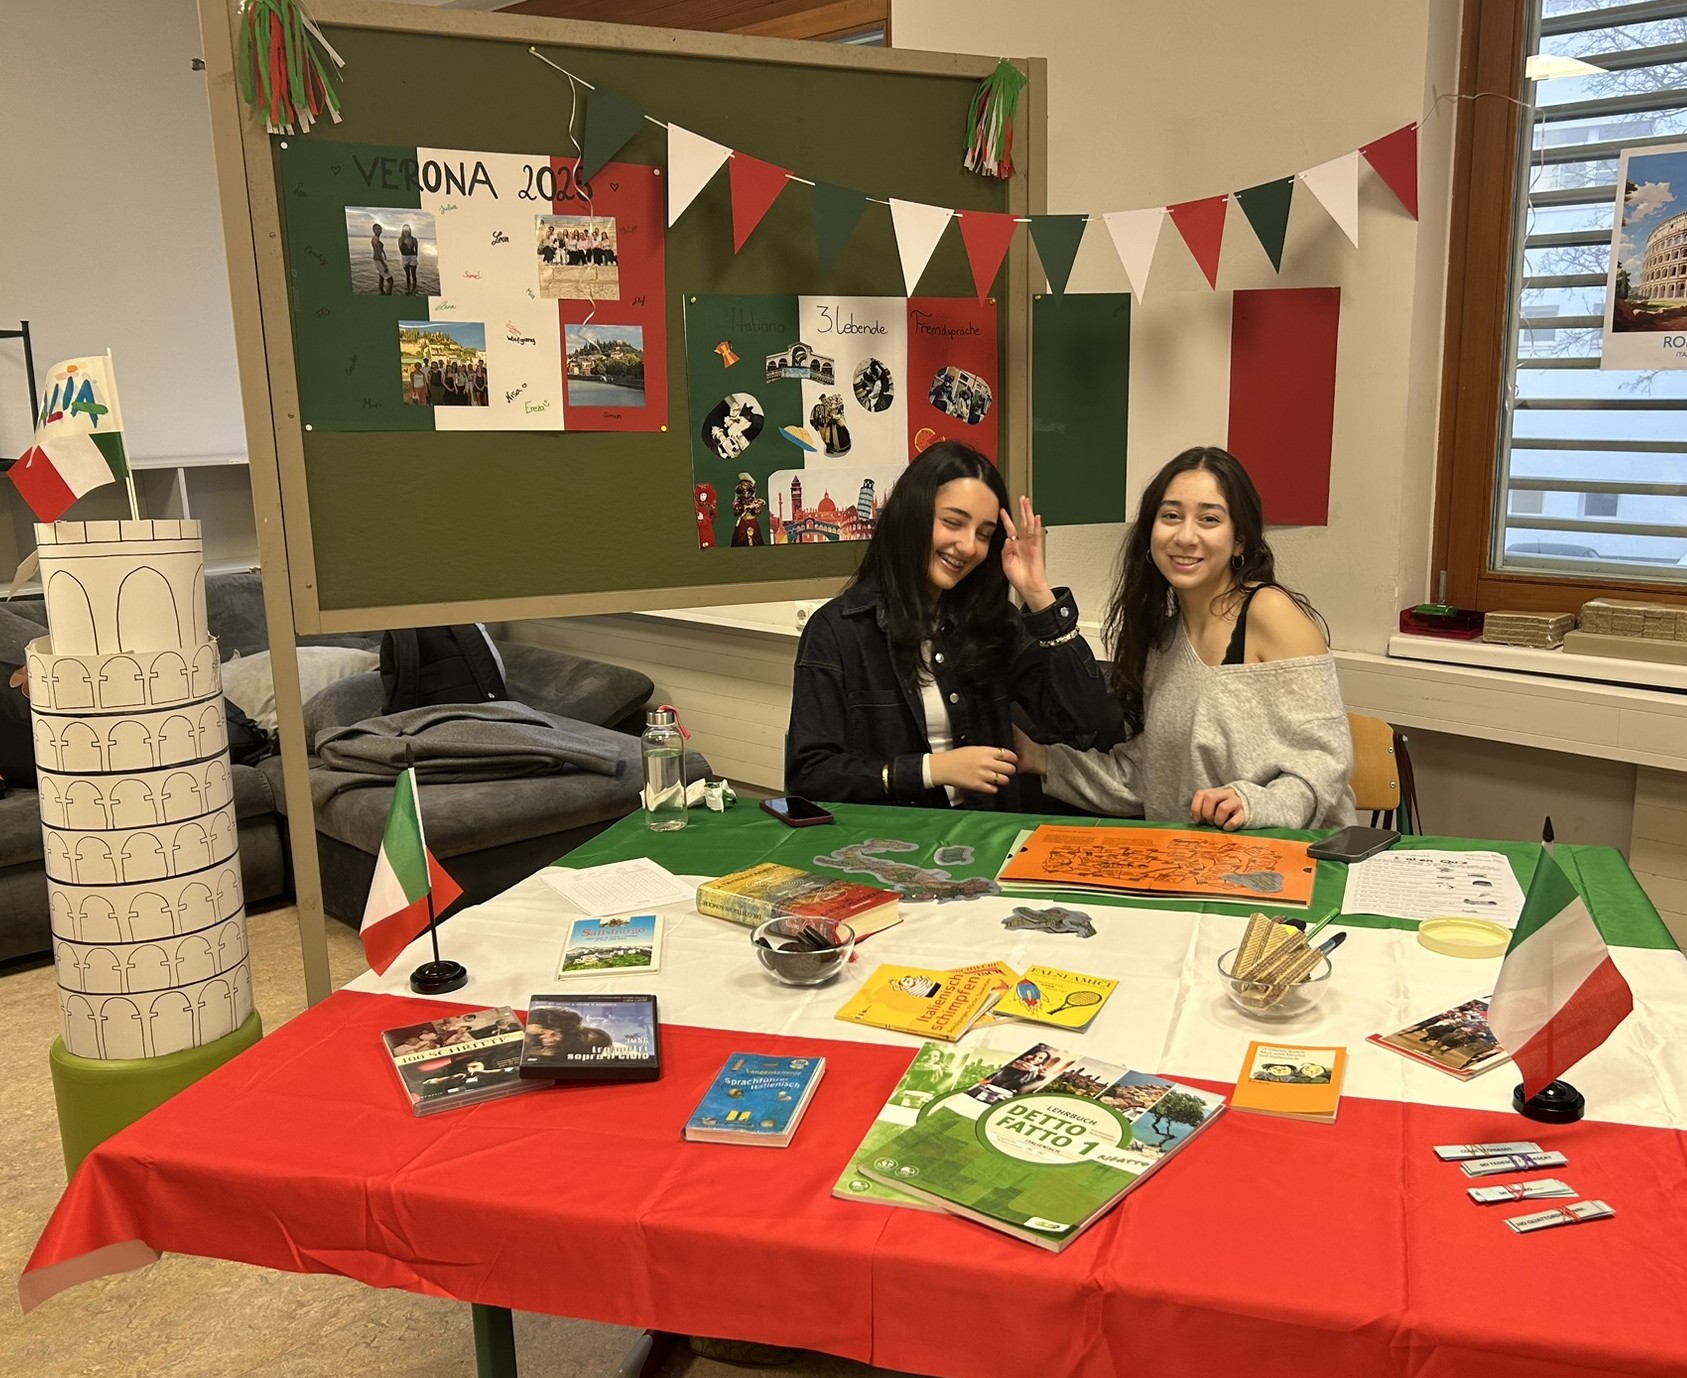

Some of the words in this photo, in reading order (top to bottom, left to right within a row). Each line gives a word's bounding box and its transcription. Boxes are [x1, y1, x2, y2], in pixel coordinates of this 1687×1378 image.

[352, 154, 498, 199] VERONA
[910, 309, 981, 341] Fremdsprache
[1663, 336, 1687, 348] RO
[1031, 967, 1068, 979] FALSI
[1073, 975, 1112, 988] AMICI
[916, 973, 964, 1022] Italienisch
[931, 976, 981, 1031] schimpfen
[402, 1054, 425, 1064] 100
[567, 1052, 604, 1062] sopra
[724, 1077, 790, 1086] Sprachführer
[750, 1081, 801, 1090] Italienisch
[1006, 1104, 1087, 1137] DETTO
[1046, 1104, 1098, 1127] LEHRBUCH
[995, 1115, 1073, 1148] FATTO
[1078, 1141, 1100, 1156] 1
